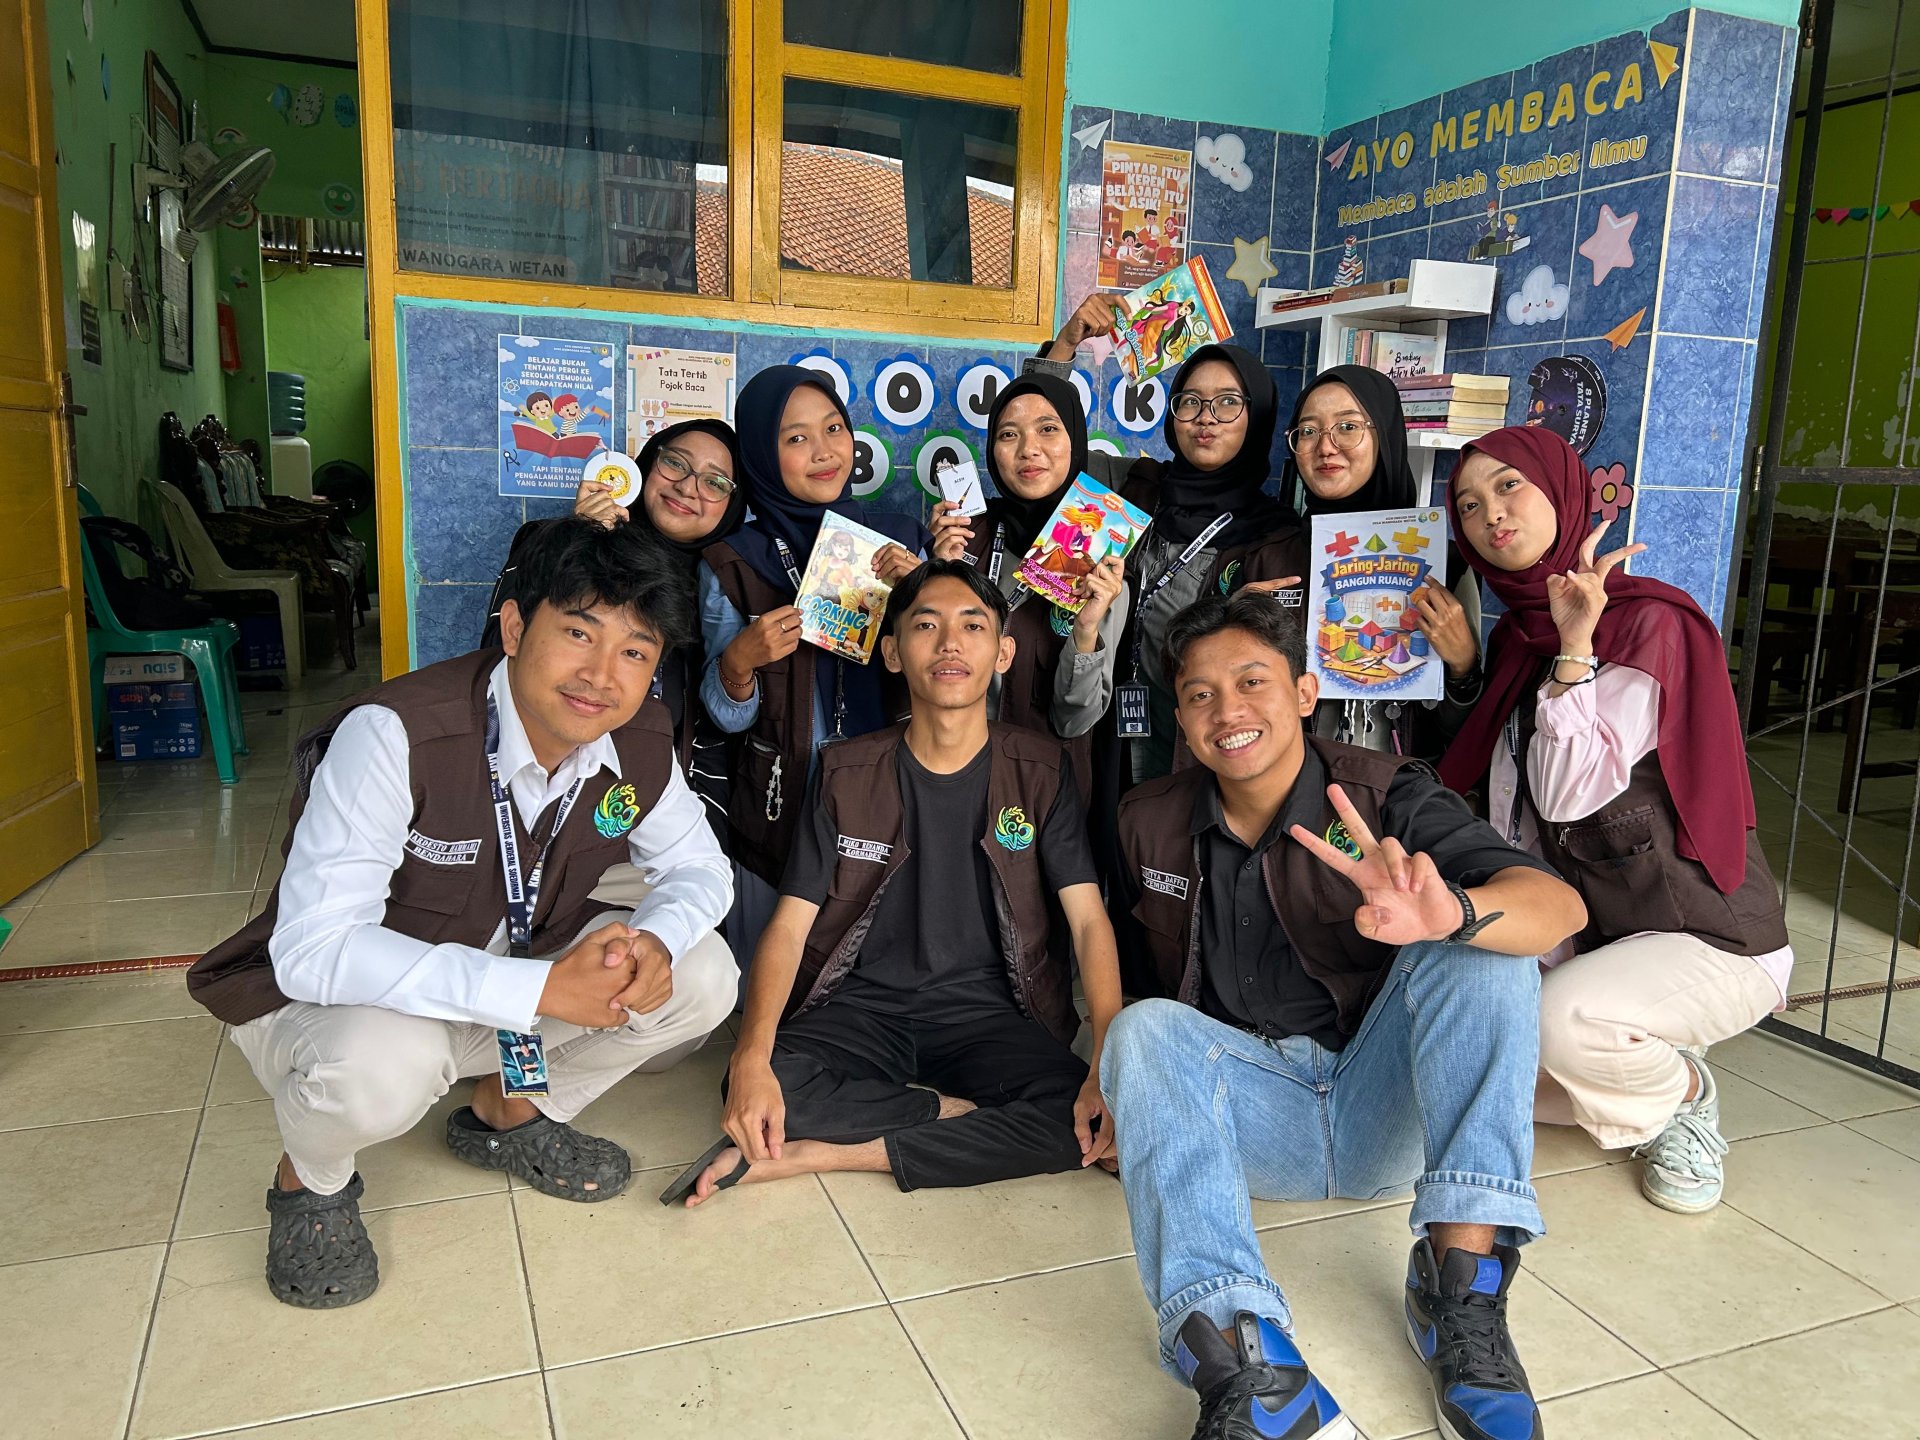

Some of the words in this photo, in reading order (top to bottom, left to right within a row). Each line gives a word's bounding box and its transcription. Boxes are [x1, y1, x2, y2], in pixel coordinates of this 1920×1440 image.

[1347, 131, 1415, 181] AYO
[1429, 62, 1643, 159] MEMBACA
[1112, 161, 1158, 174] PINTAR
[1162, 166, 1181, 180] ITU
[1127, 173, 1166, 189] KEREN
[1337, 191, 1417, 228] Membaca
[1423, 169, 1487, 207] adalah
[1496, 150, 1580, 191] Sumber
[1589, 134, 1648, 169] Ilmu
[1106, 184, 1160, 199] BELAJAR
[1164, 190, 1184, 204] ITU
[1129, 197, 1161, 211] ASIK!
[402, 248, 504, 273] WANOGARA
[509, 260, 565, 278] WETAN
[1125, 329, 1148, 375] Bidadari
[524, 363, 557, 373] TENTANG
[558, 366, 579, 374] PERGI
[528, 356, 560, 365] BELAJAR
[561, 358, 586, 367] BUKAN
[521, 371, 554, 380] SEKOLAH
[555, 373, 592, 383] KEMUDIAN
[658, 367, 678, 377] Tata
[681, 368, 707, 379] Tertib
[519, 378, 573, 389] MENDAPATKAN
[574, 381, 594, 391] NILAI
[660, 380, 683, 392] Pojok
[685, 382, 705, 392] Baca
[1568, 410, 1582, 445] SURYA
[1578, 398, 1592, 442] PLANET
[515, 472, 564, 481] PENGALAMAN
[550, 466, 582, 475] TENTANG
[516, 479, 536, 487] YANG
[1027, 558, 1045, 574] Pacu
[1330, 555, 1419, 579] Jaring-Jaring
[1022, 568, 1050, 590] Princess
[1335, 576, 1378, 590] BANGUN
[1378, 575, 1413, 587] RUANG
[800, 593, 868, 630] COOKING
[499, 804, 512, 841] UNIVERSITAS
[412, 834, 448, 852] ARDESTO
[413, 846, 467, 862] BENDAHARA
[505, 841, 517, 867] JENDERAL
[845, 848, 882, 860] KORMADES
[508, 867, 521, 900] SOEDIRMAN
[528, 869, 541, 888] KKN
[1145, 879, 1175, 893] PEMDES
[1165, 875, 1185, 888] DAFFA
